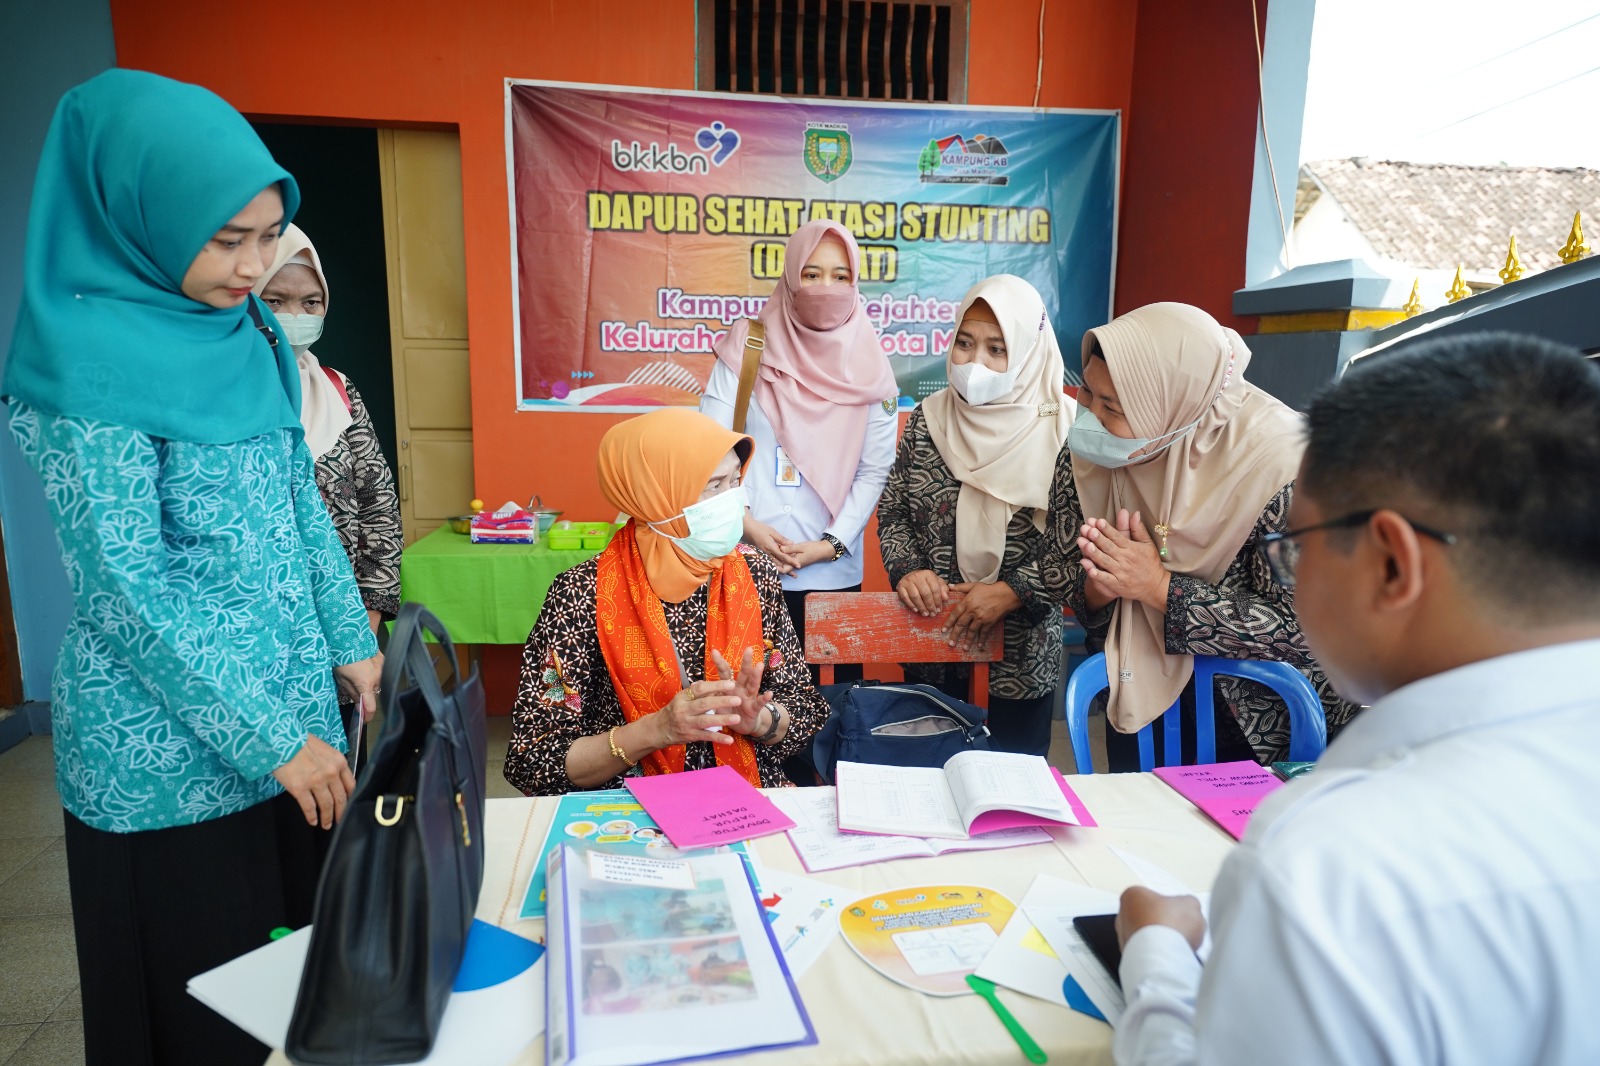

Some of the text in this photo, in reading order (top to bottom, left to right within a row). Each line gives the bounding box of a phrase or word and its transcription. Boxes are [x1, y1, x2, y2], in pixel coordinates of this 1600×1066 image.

[613, 140, 708, 174] bkkbn
[941, 154, 1008, 167] KAMPUNG KB
[587, 191, 1050, 244] DAPUR SEHAT ATASI STUNTING
[876, 331, 924, 353] ota
[701, 806, 748, 822] DASHAT
[712, 813, 756, 827] DAPUR
[711, 818, 772, 836] DONATUR
